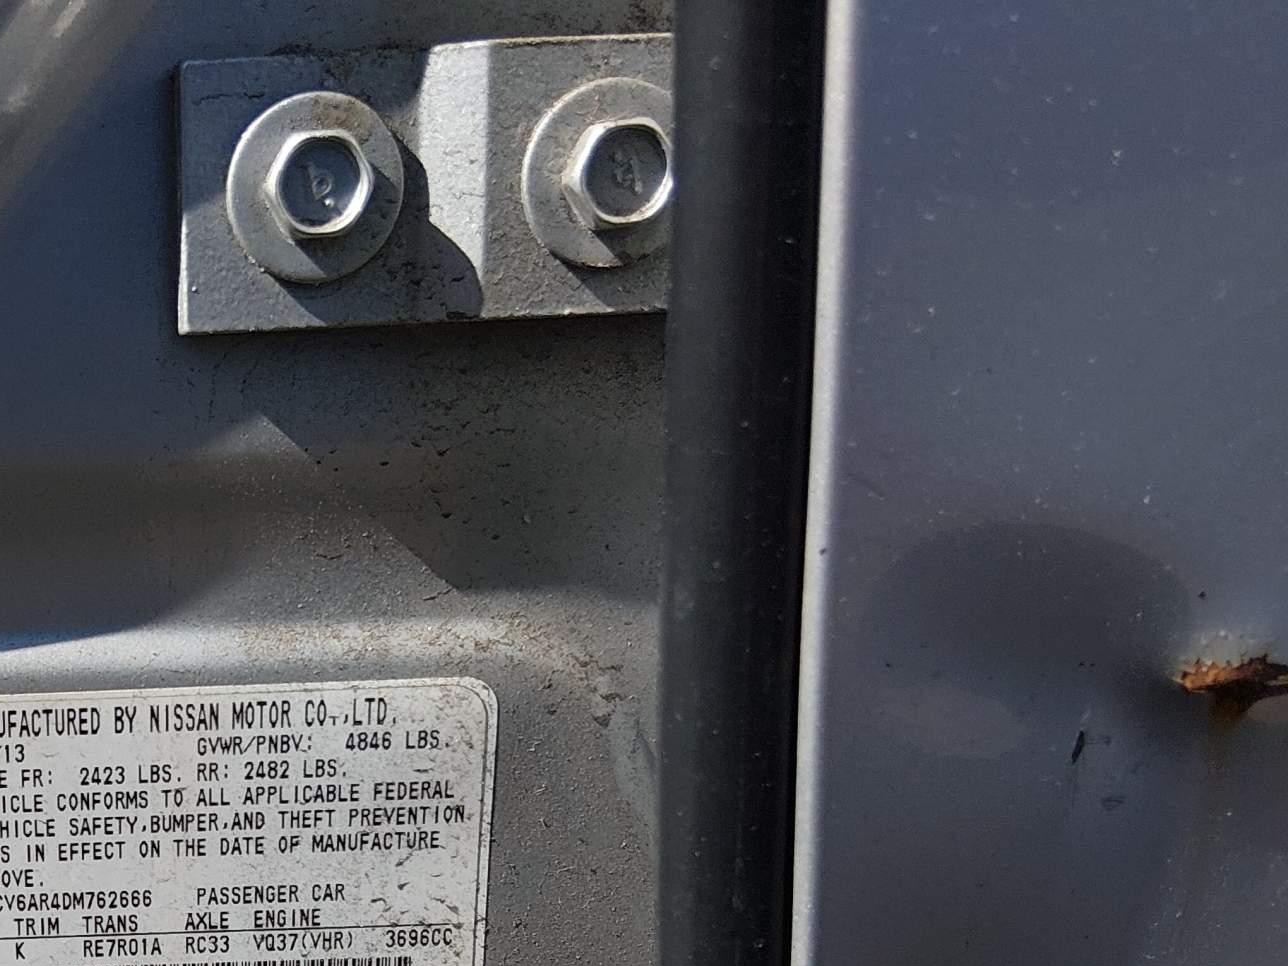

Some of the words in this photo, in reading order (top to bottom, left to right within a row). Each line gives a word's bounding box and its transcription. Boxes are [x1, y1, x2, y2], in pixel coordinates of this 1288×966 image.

[114, 705, 137, 734] BY
[149, 702, 220, 734] NISSAN
[231, 700, 291, 730] MOTOR
[197, 734, 313, 756] GVWR/PNBV:
[345, 731, 392, 751] 4846
[405, 729, 450, 750] LBS.
[21, 767, 53, 787] FR:
[79, 765, 126, 786] 2423
[137, 763, 182, 784] LBS.
[196, 761, 229, 782] RR:
[244, 759, 290, 780] 2482
[303, 758, 347, 779] LBS.
[57, 790, 149, 812] CONFORMS
[161, 788, 184, 808] TO
[196, 787, 230, 807] ALL
[242, 783, 360, 805] APPLICABLE
[373, 780, 454, 801] FEDERAL
[278, 808, 336, 829] THEFT
[348, 804, 465, 828] PREVENTION
[26, 843, 45, 863] IN
[58, 840, 126, 862] EFFECT
[139, 839, 161, 859] ON
[172, 838, 207, 858] THE
[220, 836, 265, 857] DATE
[278, 835, 300, 854] OF
[311, 831, 441, 852] MANUFACTURE
[196, 884, 299, 905] PASSENGER
[311, 883, 345, 902] CAR
[14, 917, 60, 936] TRIM
[82, 914, 139, 934] TRANS
[185, 911, 230, 930] AXLE
[253, 908, 321, 928] ENGINE
[15, 941, 26, 960] K
[185, 934, 230, 954] RC33
[253, 930, 353, 952] VQ37(VHR)
[385, 928, 453, 948] 3696CC
